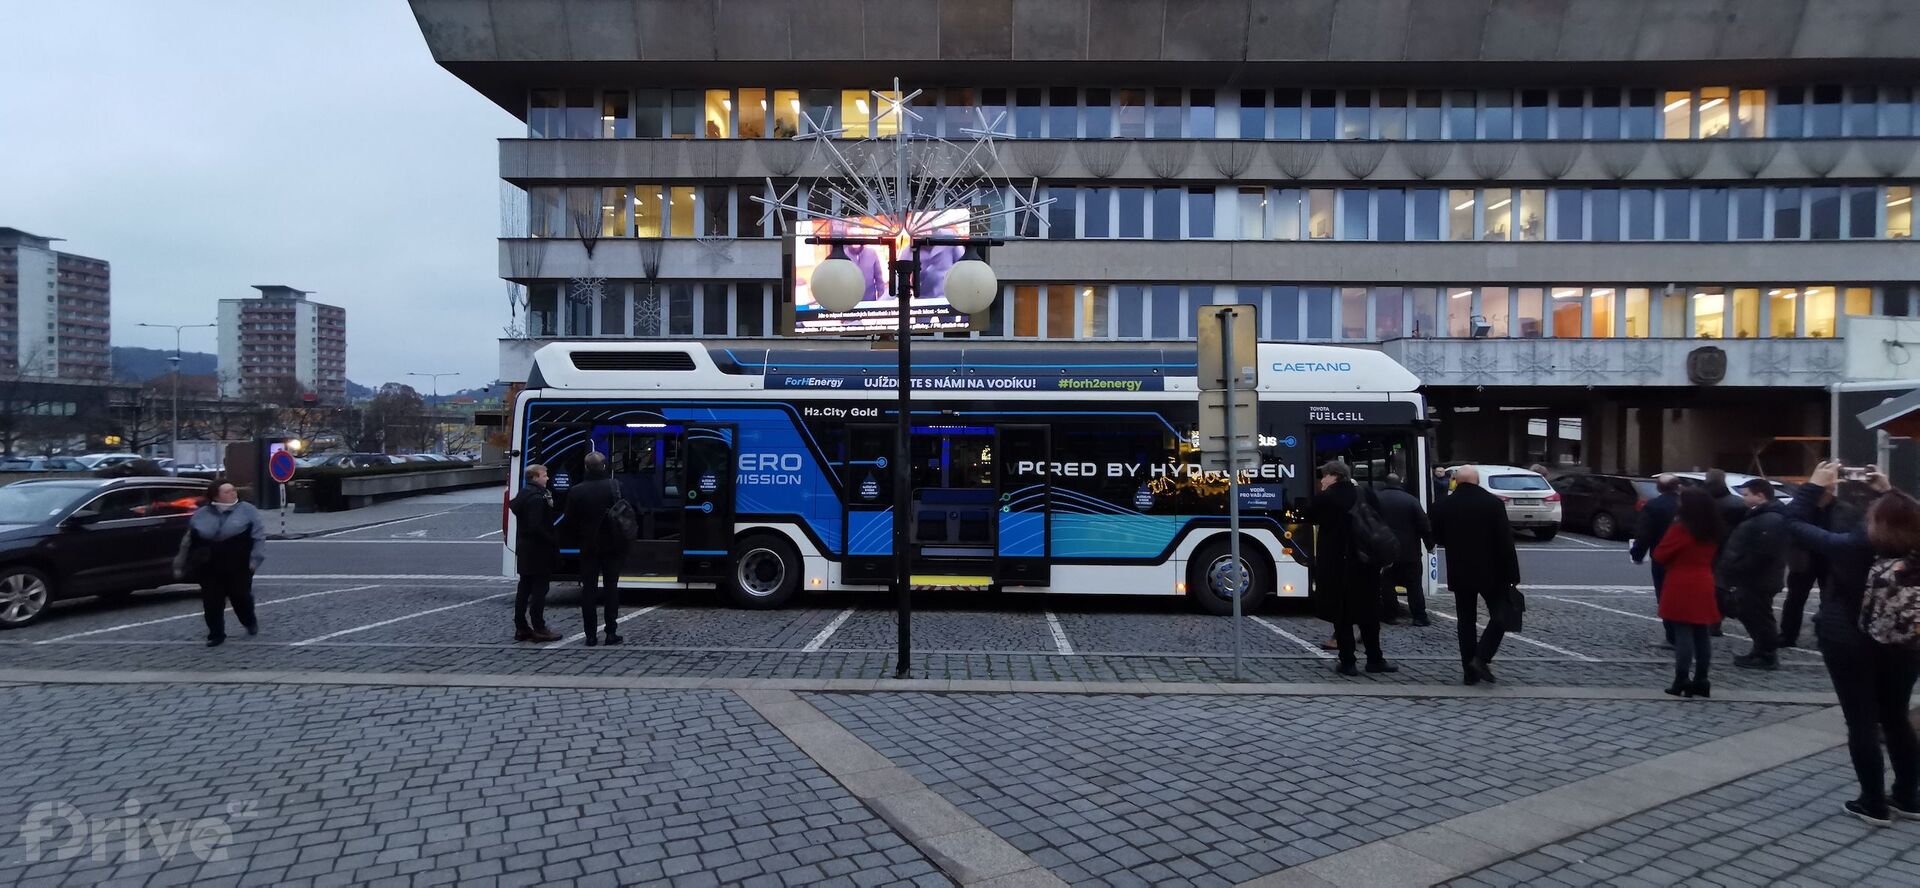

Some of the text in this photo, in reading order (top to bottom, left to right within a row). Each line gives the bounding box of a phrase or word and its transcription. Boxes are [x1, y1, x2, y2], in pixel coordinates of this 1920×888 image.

[1272, 362, 1351, 372] CAETANO
[784, 375, 1142, 391] ForHEnergy UJÍŽDTE S NÁMI NA VODÍKU! #forh2energy
[850, 407, 878, 417] Gold
[1309, 412, 1364, 421] FUELCELL
[738, 453, 803, 471] ERO
[1107, 463, 1140, 477] BY
[735, 474, 802, 485] MISSION
